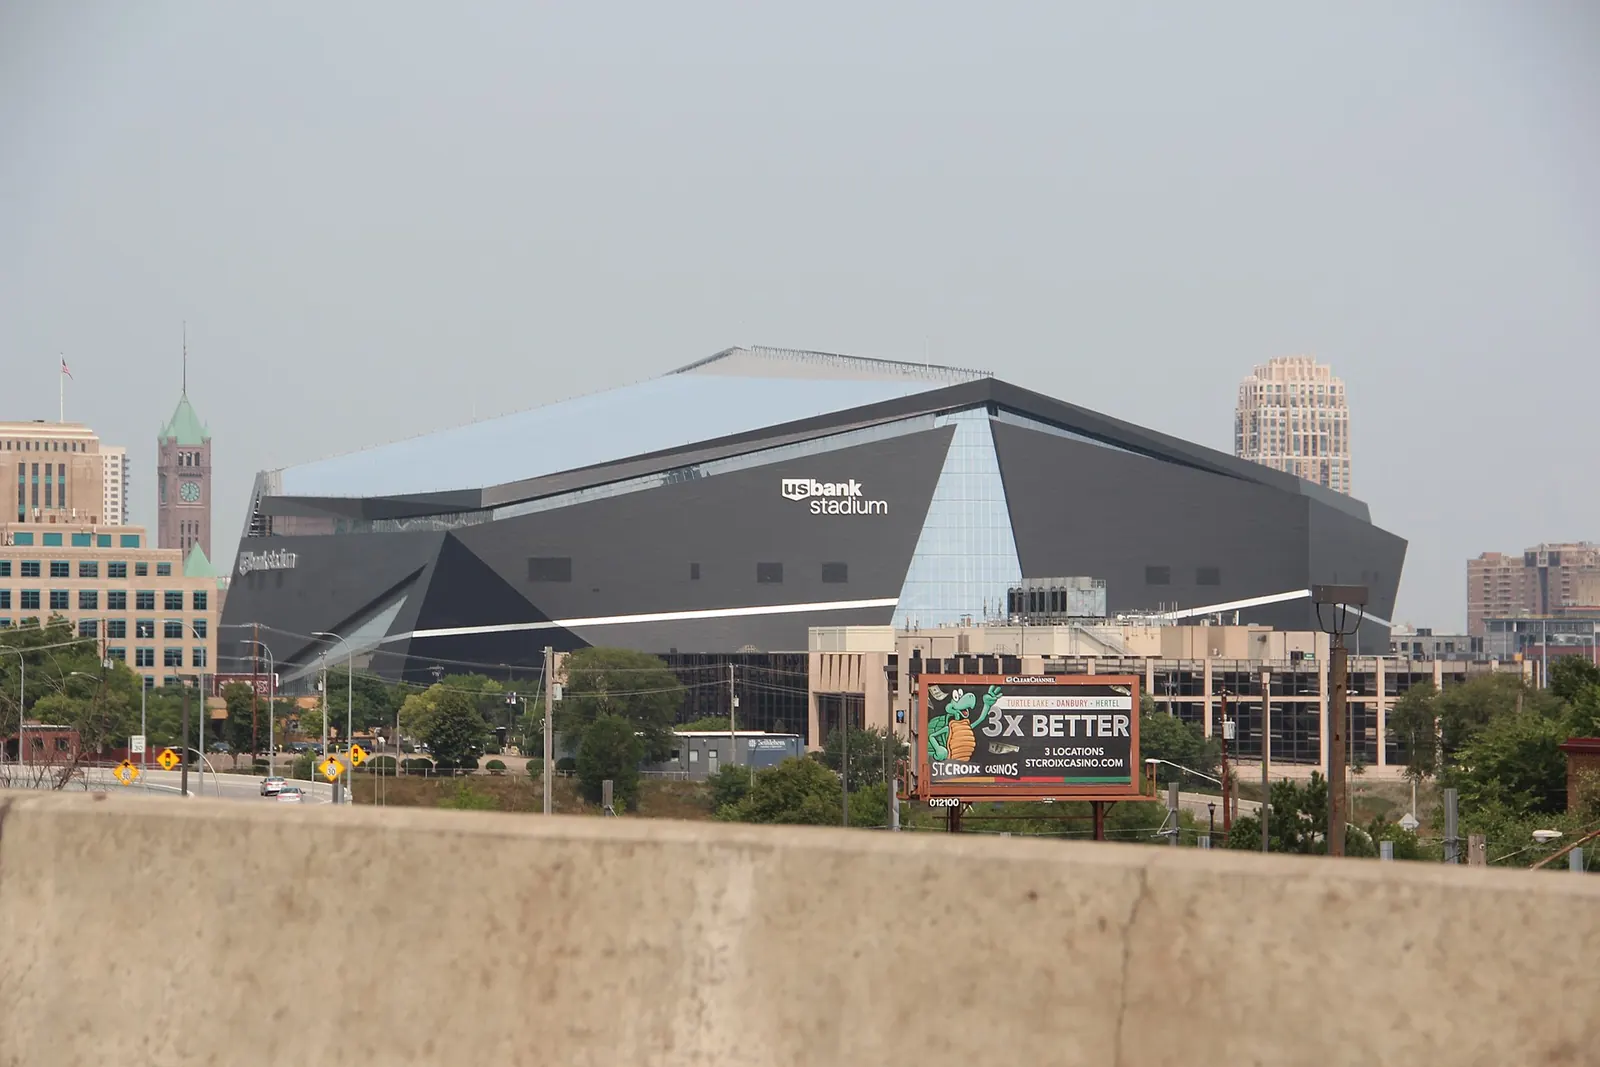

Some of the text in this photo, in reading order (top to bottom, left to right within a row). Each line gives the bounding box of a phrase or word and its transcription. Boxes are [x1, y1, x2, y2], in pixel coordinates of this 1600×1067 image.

[810, 497, 888, 515] stadium
[1007, 699, 1119, 707] TURTLE LAKE DANBURY HERTEL
[1032, 714, 1130, 737] BETTER
[1044, 747, 1104, 756] 3 LOCATIONS
[1025, 758, 1124, 768] STCROIXCASINO.COM
[327, 768, 336, 776] 30
[984, 763, 1018, 775] CASINOS
[929, 798, 960, 807] 012100
